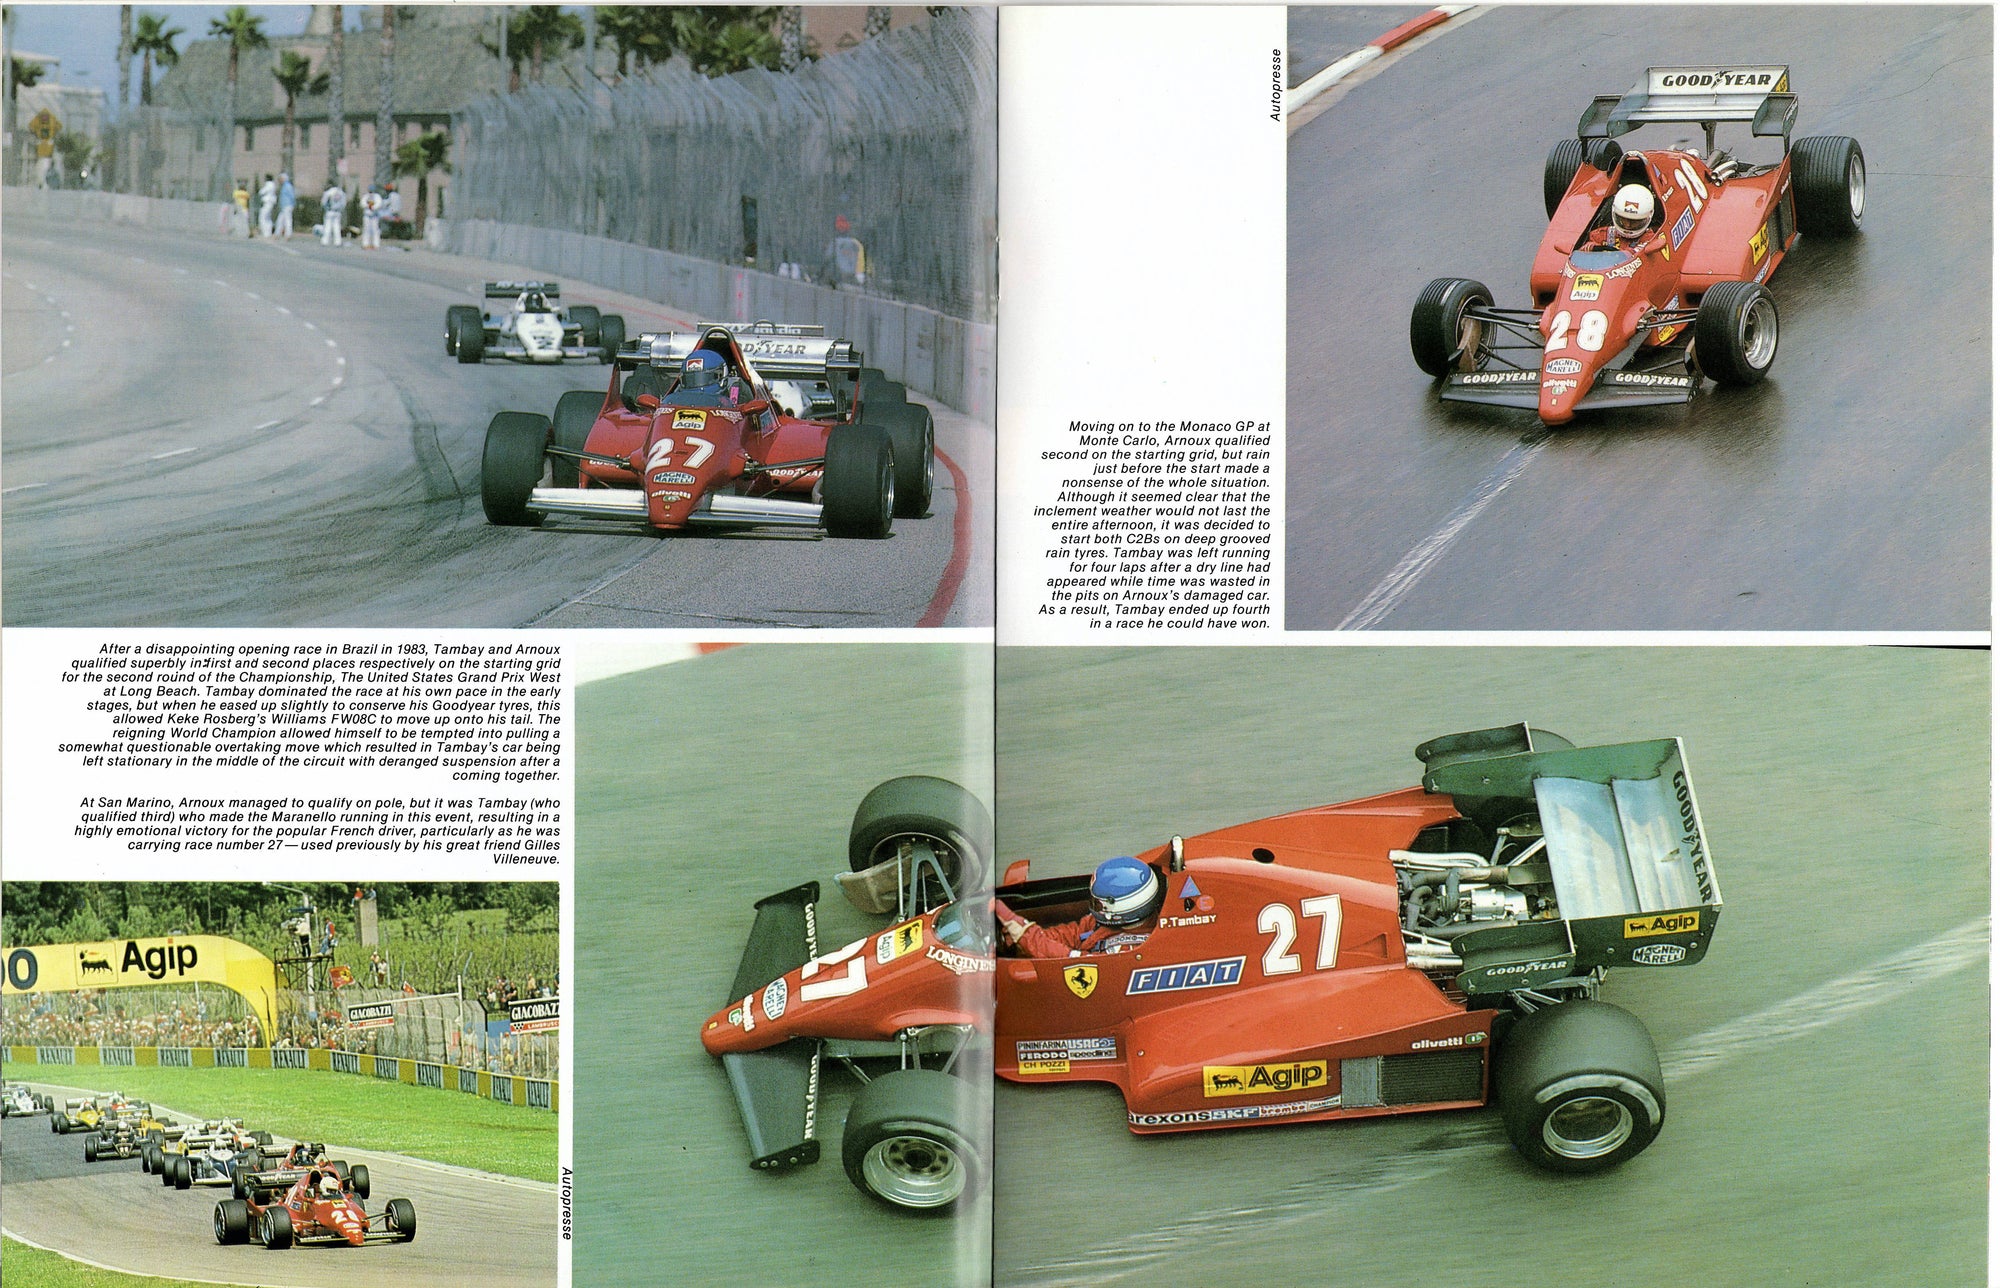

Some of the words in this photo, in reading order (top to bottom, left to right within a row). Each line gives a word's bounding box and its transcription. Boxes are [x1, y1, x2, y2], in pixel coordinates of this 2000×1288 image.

[1270, 49, 1283, 122] Autopresse
[1662, 73, 1772, 88] GOODYEAR
[1672, 208, 1695, 249] FIAT
[1573, 290, 1597, 300] Agip
[1544, 309, 1609, 354] 28
[1462, 372, 1538, 385] GOODYEAR
[1615, 372, 1689, 387] GOODYEAR
[675, 420, 702, 430] Agip
[1069, 421, 1115, 434] Moving
[1118, 423, 1134, 432] on
[1139, 422, 1151, 432] to
[1155, 421, 1176, 432] the
[1180, 421, 1231, 432] Monaco
[1235, 421, 1255, 432] GP
[1258, 422, 1270, 432] at
[1079, 435, 1119, 446] Monte
[1123, 435, 1159, 447] Carlo,
[1164, 435, 1211, 446] Arnoux
[1215, 435, 1271, 448] qualified
[646, 436, 716, 475] 27
[1041, 449, 1089, 460] second
[1092, 451, 1107, 459] on
[1112, 449, 1131, 459] the
[1135, 449, 1185, 462] starting
[1189, 449, 1217, 462] grid,
[1222, 449, 1243, 459] but
[1246, 449, 1270, 459] rain
[651, 490, 692, 500] olivetti
[1061, 534, 1090, 544] start
[1094, 533, 1122, 544] both
[1127, 533, 1160, 544] C2Bs
[1164, 536, 1180, 544] on
[1184, 534, 1216, 546] deep
[1219, 533, 1271, 547] grooved
[1090, 618, 1101, 628] in
[1105, 620, 1112, 628] a
[1116, 620, 1144, 628] race
[1147, 618, 1163, 628] he
[1167, 618, 1204, 628] could
[1207, 618, 1237, 628] have
[1241, 620, 1269, 628] won.
[99, 643, 131, 654] After
[134, 646, 141, 654] a
[146, 643, 235, 657] disappointing
[238, 644, 290, 657] opening
[293, 646, 322, 654] race
[326, 644, 338, 654] in
[342, 644, 378, 654] Brazil
[381, 644, 392, 654] in
[398, 644, 428, 656] 1983,
[434, 644, 485, 657] Tambay
[488, 644, 512, 655] and
[515, 644, 560, 655] Arnoux
[62, 671, 80, 682] for
[83, 671, 103, 682] the
[106, 671, 153, 682] second
[157, 671, 195, 682] round
[198, 671, 212, 682] of
[216, 672, 235, 682] the
[239, 671, 335, 685] Championship,
[341, 672, 363, 682] The
[368, 672, 409, 683] United
[412, 671, 453, 683] States
[458, 672, 497, 683] Grand
[501, 672, 525, 682] Prix
[530, 672, 561, 683] West
[113, 713, 163, 724] allowed
[167, 713, 199, 724] Keke
[272, 713, 326, 724] Williams
[331, 713, 377, 724] FW08C
[381, 714, 392, 724] to
[396, 716, 430, 724] move
[434, 716, 450, 727] up
[454, 715, 483, 725] onto
[487, 714, 506, 724] his
[511, 714, 533, 725] tail.
[539, 714, 561, 724] The
[80, 797, 95, 808] At
[98, 797, 122, 808] San
[126, 797, 174, 809] Marino,
[178, 797, 225, 808] Arnoux
[229, 797, 288, 811] managed
[292, 798, 304, 808] to
[308, 797, 353, 810] qualify
[356, 800, 371, 808] on
[375, 798, 405, 810] pole,
[409, 798, 431, 808] but
[434, 798, 443, 808] it
[448, 800, 473, 808] was
[478, 798, 527, 811] Tambay
[530, 798, 560, 810] (who
[1672, 770, 1713, 904] GOODYEAR
[493, 853, 559, 864] Villeneuve.
[1650, 915, 1696, 932] Agip
[1258, 893, 1343, 976] 27
[877, 934, 893, 960] Agip
[1, 948, 38, 991] 0
[120, 938, 199, 980] Agip
[1487, 960, 1567, 976] GOODYEAR
[1136, 963, 1238, 990] FIAT
[350, 1004, 392, 1019] GIACOBAZZI
[1018, 1039, 1068, 1050] PININFARINA
[1411, 1036, 1463, 1050] olivetti
[1020, 1051, 1068, 1060] FERODO
[1040, 1060, 1066, 1069] POZZI
[1248, 1063, 1323, 1091] Agip
[1211, 1108, 1260, 1120] SKF
[560, 1166, 573, 1241] Autopresse
